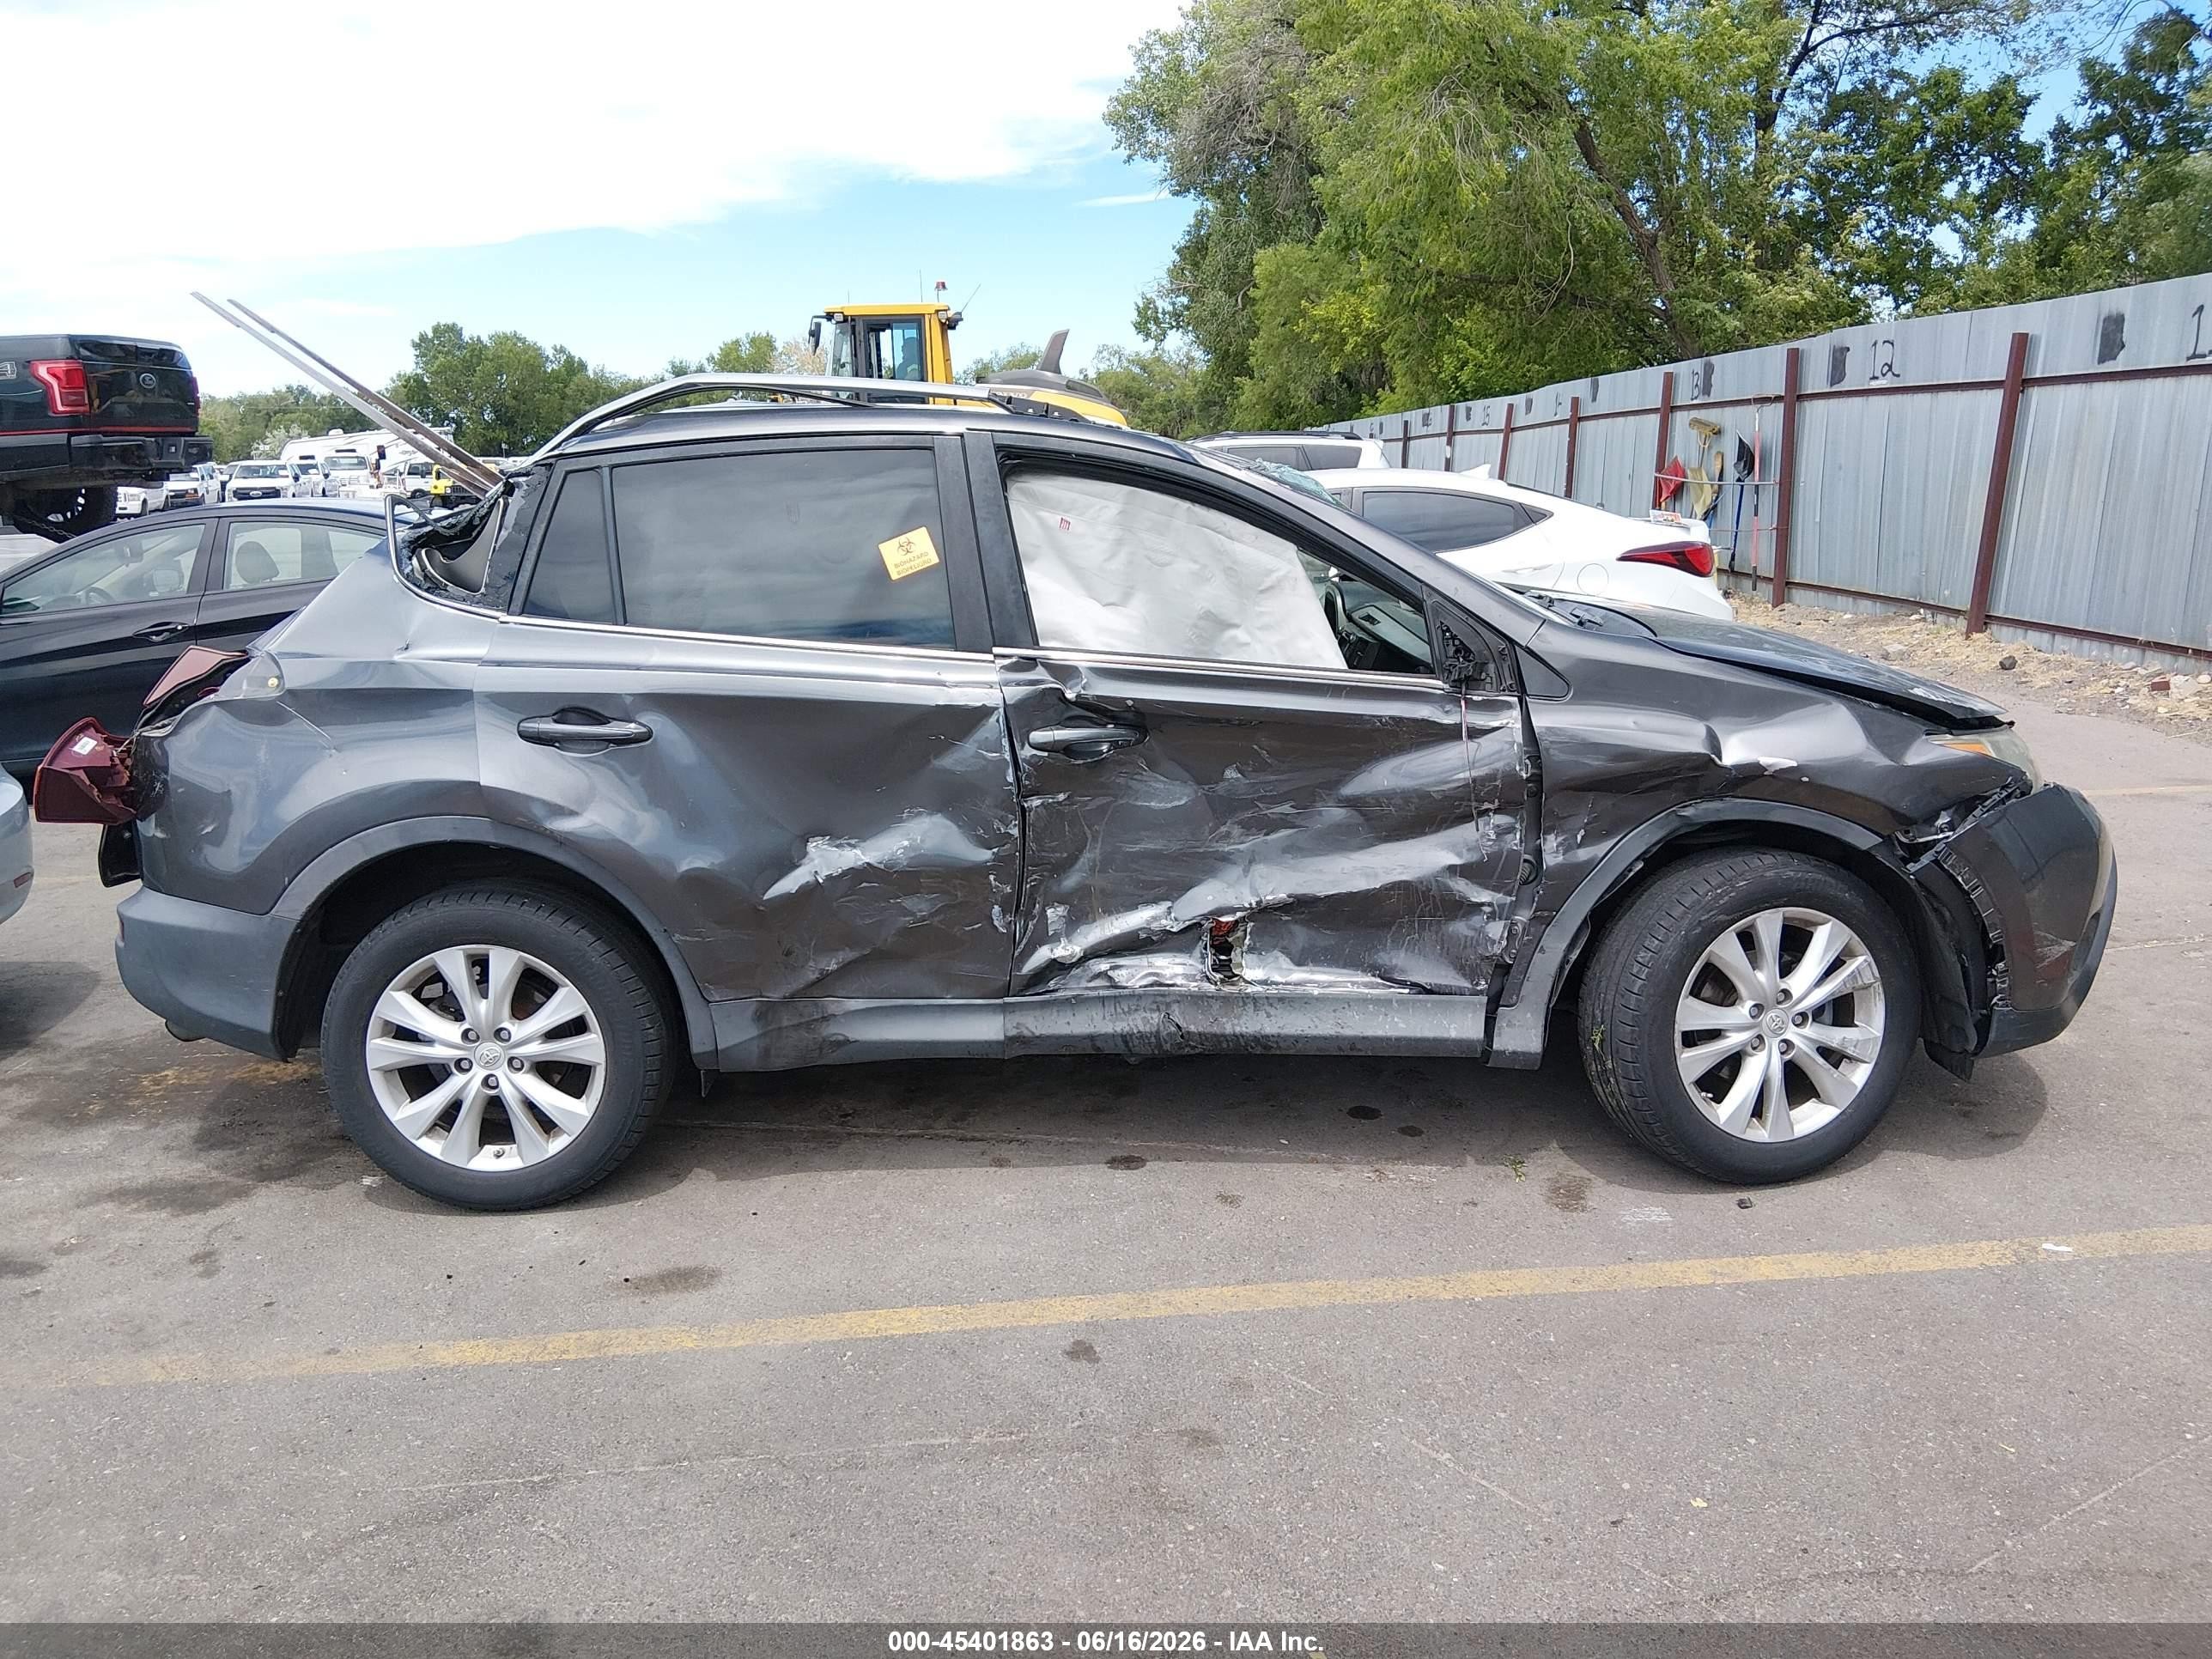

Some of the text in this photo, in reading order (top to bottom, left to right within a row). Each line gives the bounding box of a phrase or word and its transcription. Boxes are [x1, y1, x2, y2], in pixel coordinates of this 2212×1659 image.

[2186, 304, 2212, 362] 1
[1869, 339, 1901, 380] 12
[894, 551, 929, 568] BIOHAZARD
